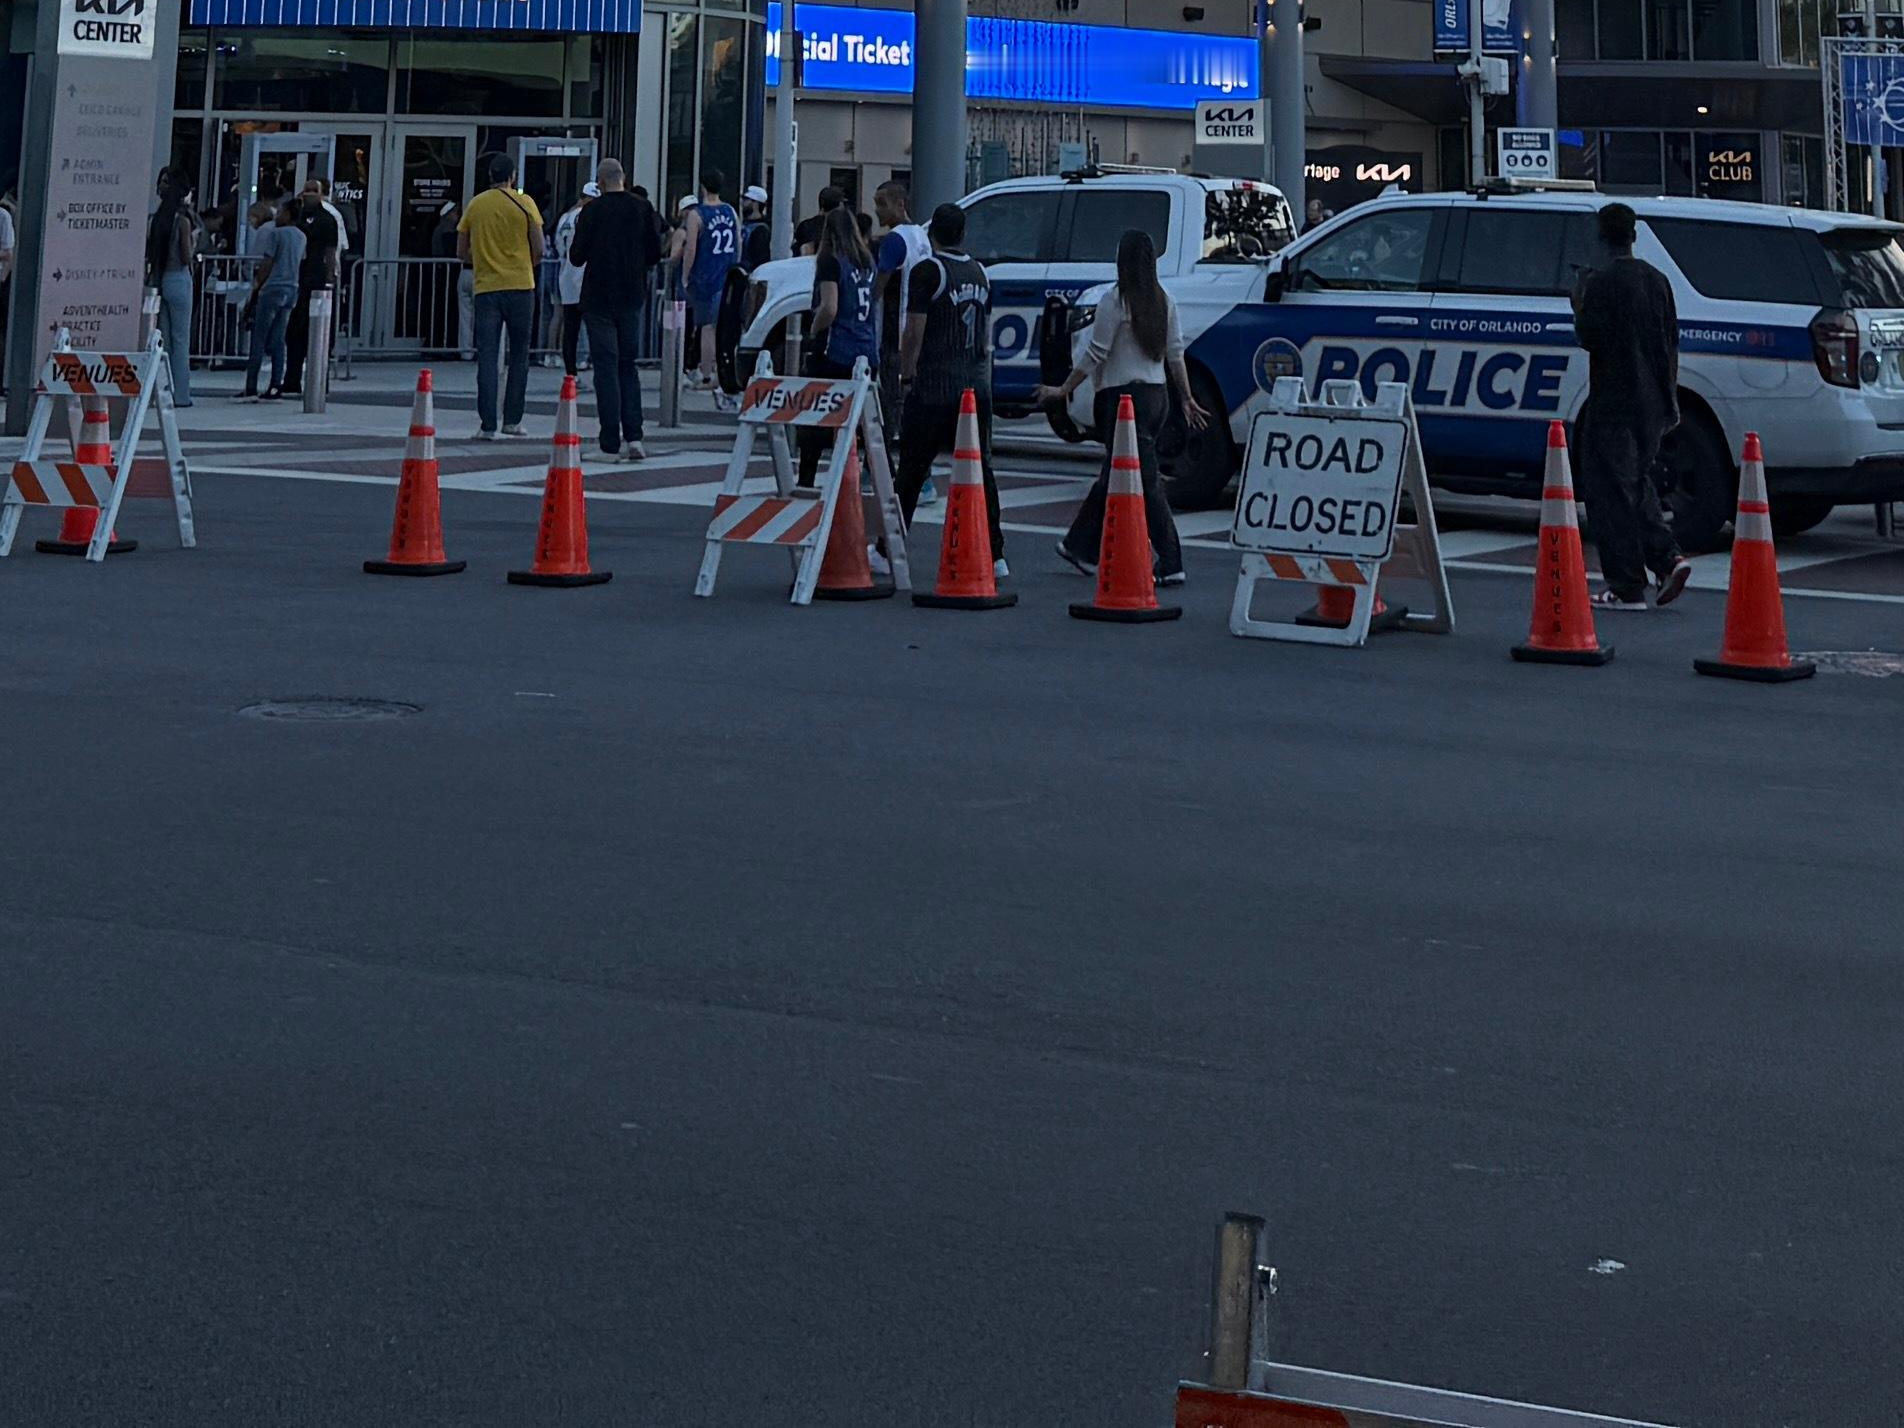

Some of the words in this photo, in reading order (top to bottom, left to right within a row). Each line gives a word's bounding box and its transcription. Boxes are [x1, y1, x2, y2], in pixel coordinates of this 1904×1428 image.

[73, 19, 143, 44] CENTER
[1205, 124, 1255, 139] CENTER
[1304, 163, 1341, 182] rtage
[1708, 165, 1753, 181] CLUB
[68, 217, 130, 230] TICKETMASTER
[711, 229, 735, 255] 22
[857, 287, 871, 322] 5
[1045, 288, 1066, 298] CITY
[961, 303, 976, 349] 1
[1430, 318, 1458, 332] CITY
[1459, 319, 1477, 332] OF
[1479, 320, 1542, 334] ORLANDO
[1678, 328, 1743, 343] MERGENCY
[52, 363, 138, 384] VENUES
[1312, 345, 1570, 412] POLICE
[753, 388, 846, 413] VENUES
[1263, 431, 1384, 474] ROAD
[1245, 491, 1386, 538] CLOSED
[1550, 531, 1563, 633] VENUES
